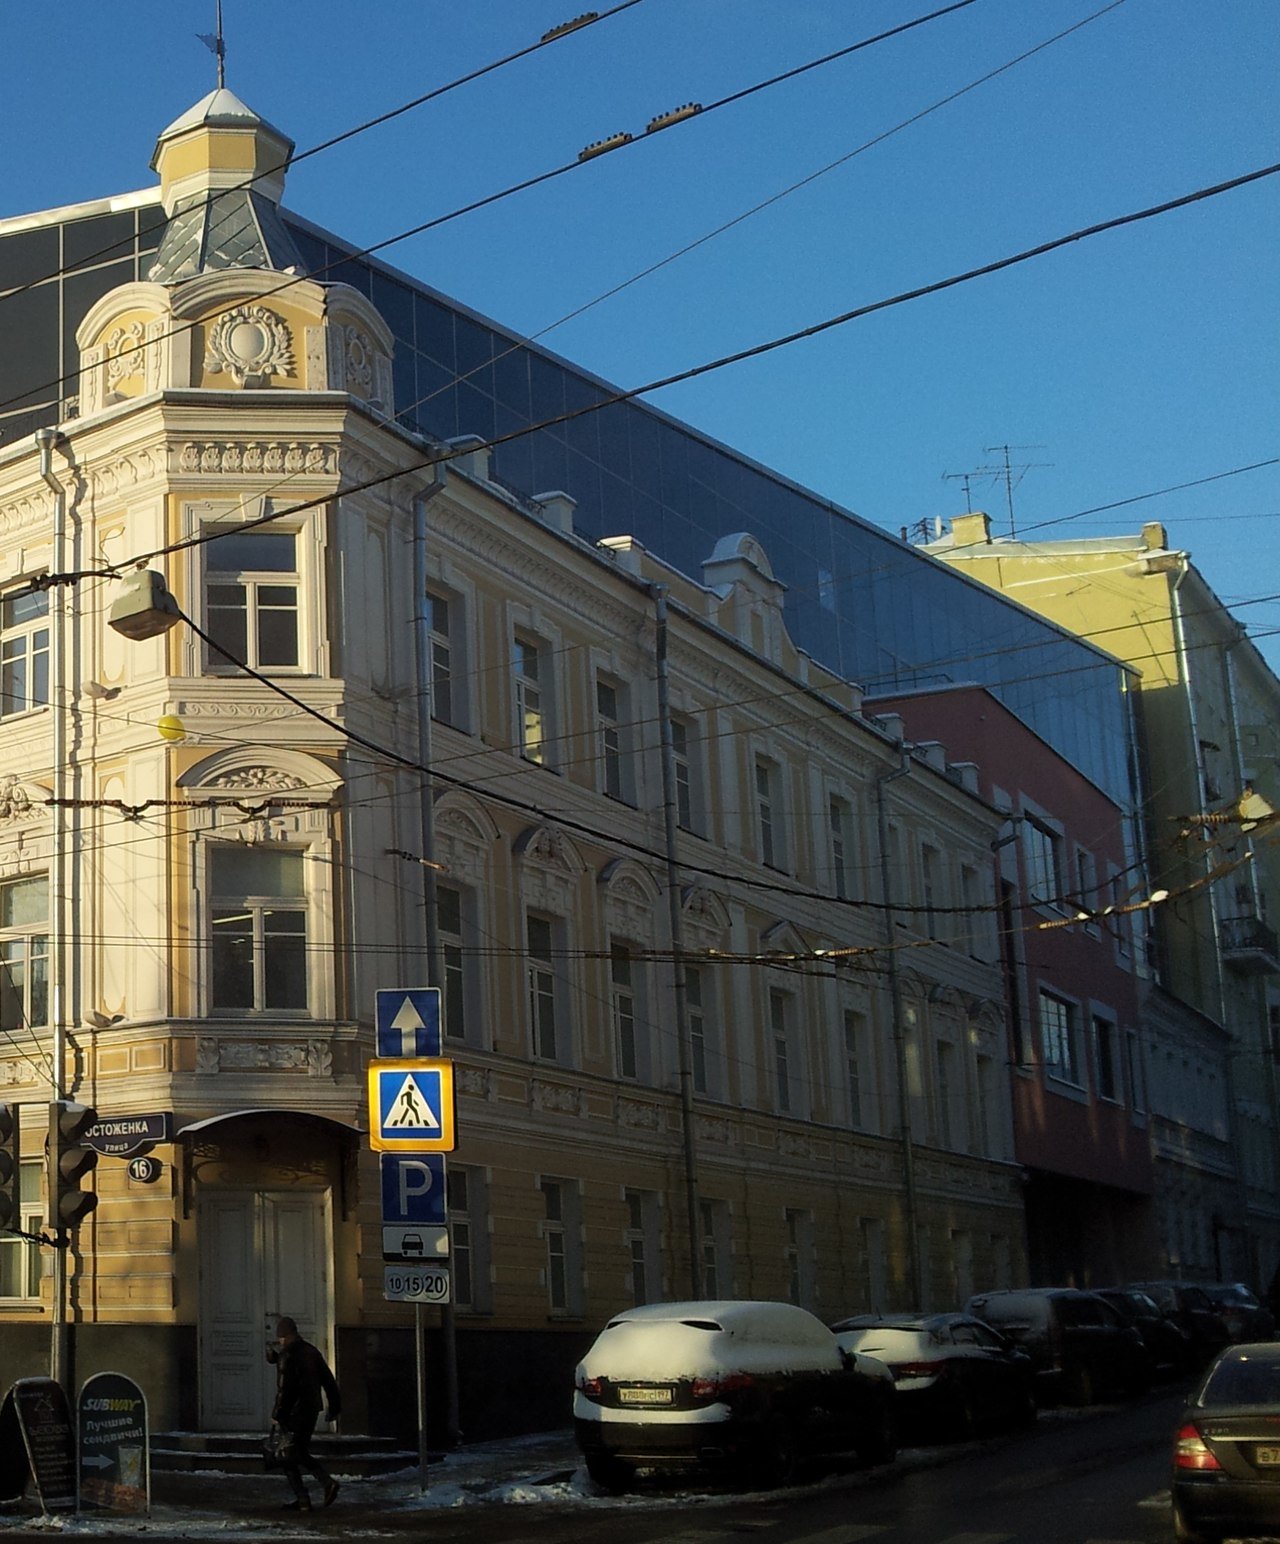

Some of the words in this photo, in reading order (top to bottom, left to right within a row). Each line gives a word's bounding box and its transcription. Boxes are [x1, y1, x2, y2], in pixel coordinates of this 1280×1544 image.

[105, 1142, 129, 1152] улица
[132, 1160, 148, 1178] 16
[398, 1160, 433, 1216] P
[389, 1277, 402, 1290] 10
[404, 1276, 420, 1292] 15
[425, 1275, 444, 1294] 20
[83, 1398, 141, 1412] SUBWAY
[86, 1416, 133, 1432] Лучшие
